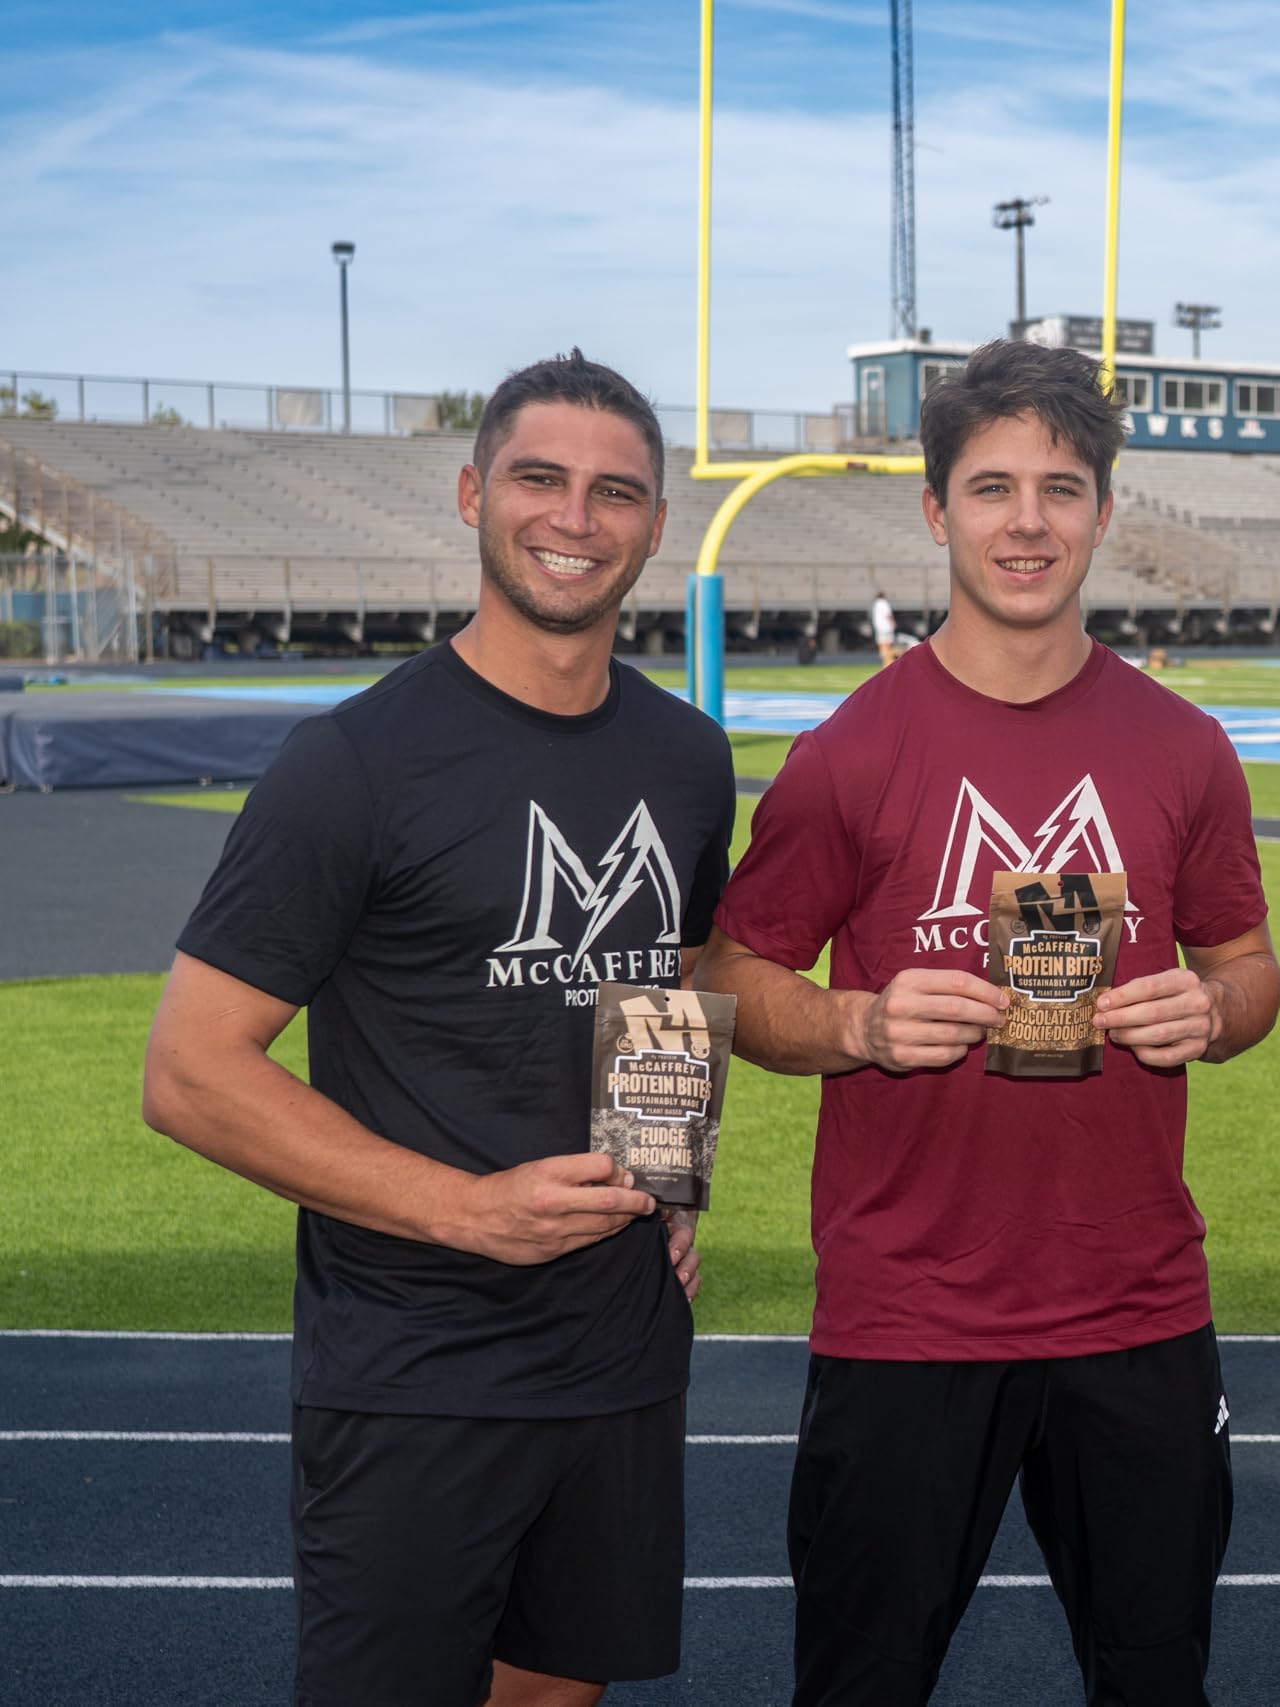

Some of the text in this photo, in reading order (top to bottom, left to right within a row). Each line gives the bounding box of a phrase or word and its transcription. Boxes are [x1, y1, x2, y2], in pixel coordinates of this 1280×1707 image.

[1022, 941, 1086, 954] McCAFFREY
[485, 948, 682, 988] McCAFFRE
[1002, 954, 1064, 976] PROTEIN
[1065, 955, 1103, 976] BITES
[1018, 978, 1089, 987] SUSTAINABLY MADE
[1005, 1005, 1093, 1026] CHOCOLATE CHIP
[1008, 1021, 1089, 1041] COOKIE DOUGH
[628, 1061, 697, 1076] McCAFFREY
[606, 1072, 713, 1102] PROTEIN BITES
[625, 1095, 699, 1110] SUSTAINABLY MADE
[640, 1126, 687, 1147] FUDGE
[629, 1146, 693, 1168] BROWNIE
